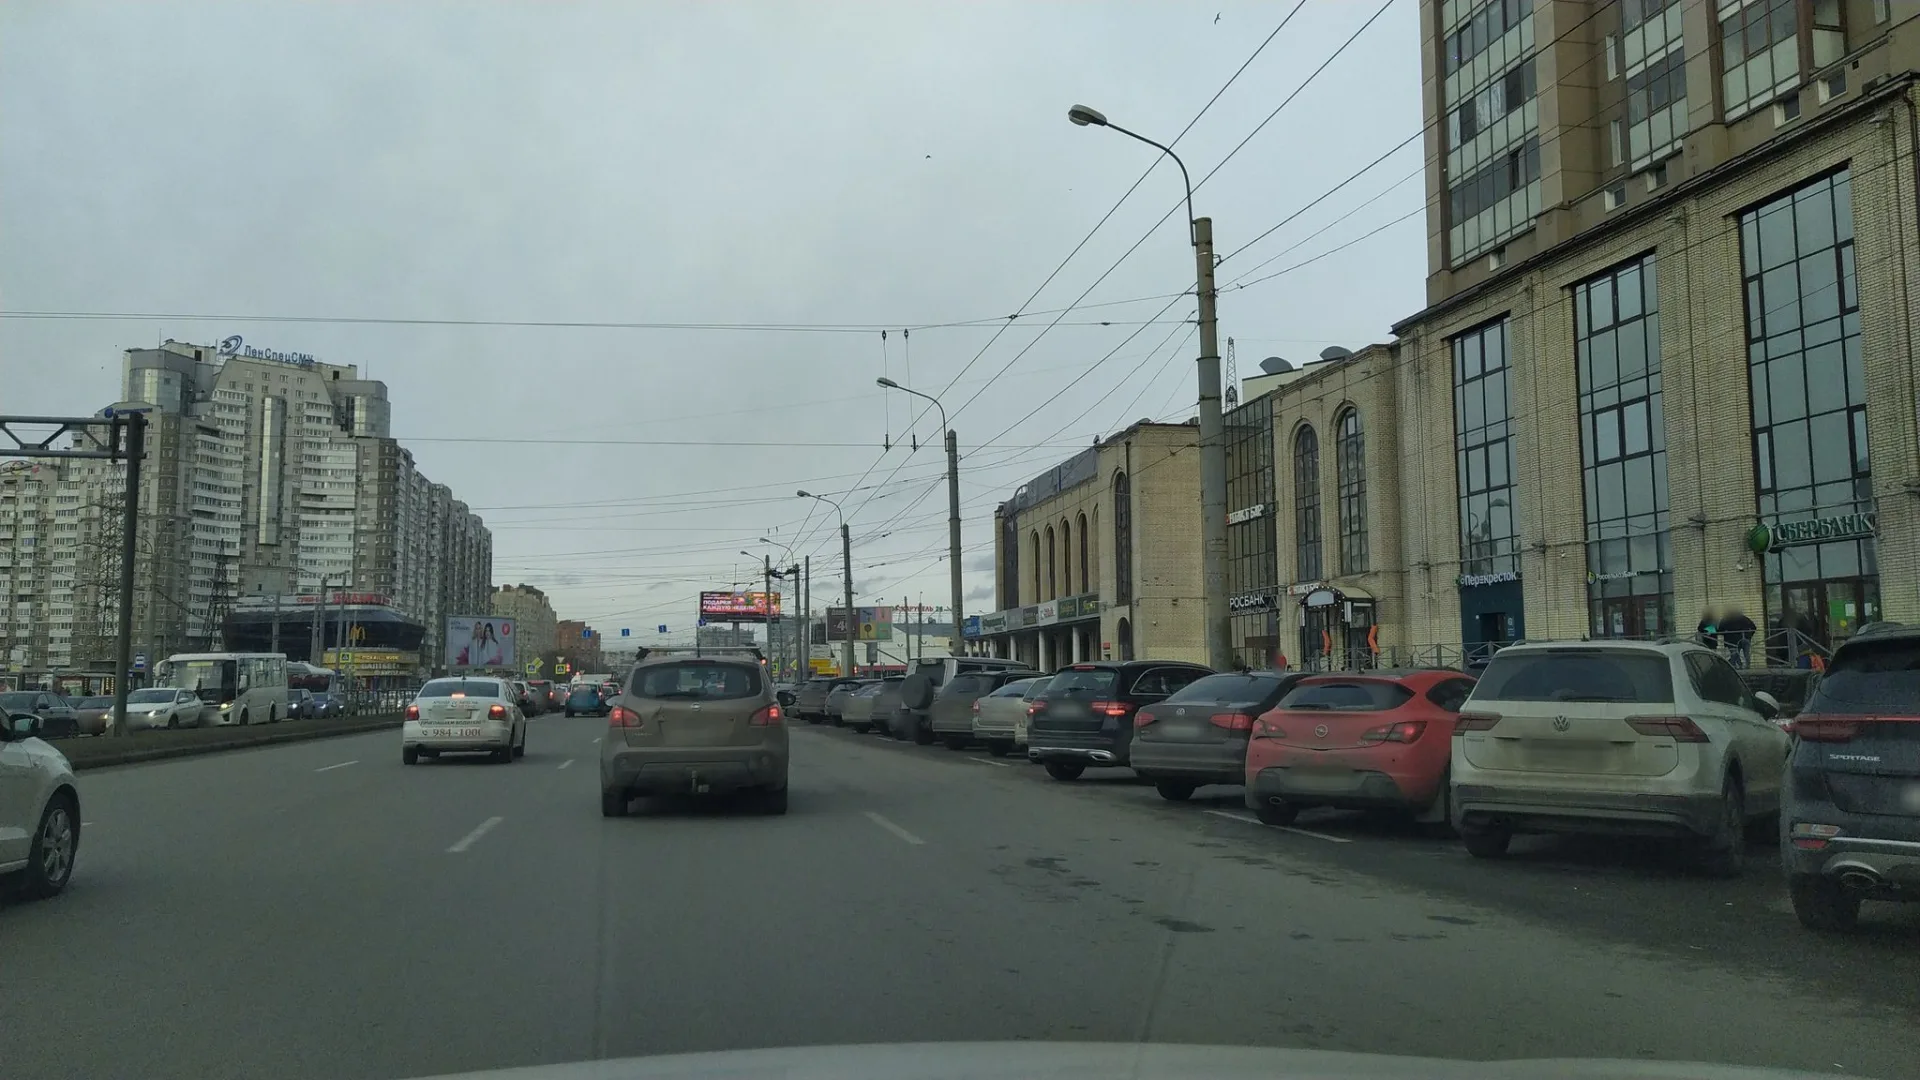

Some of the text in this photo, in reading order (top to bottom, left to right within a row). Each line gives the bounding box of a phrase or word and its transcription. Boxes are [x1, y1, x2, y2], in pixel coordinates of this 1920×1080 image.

[1775, 512, 1876, 541] СБЕРБАНК
[1229, 593, 1265, 609] РОСБАНК
[1829, 754, 1881, 762] SPORTAGE
